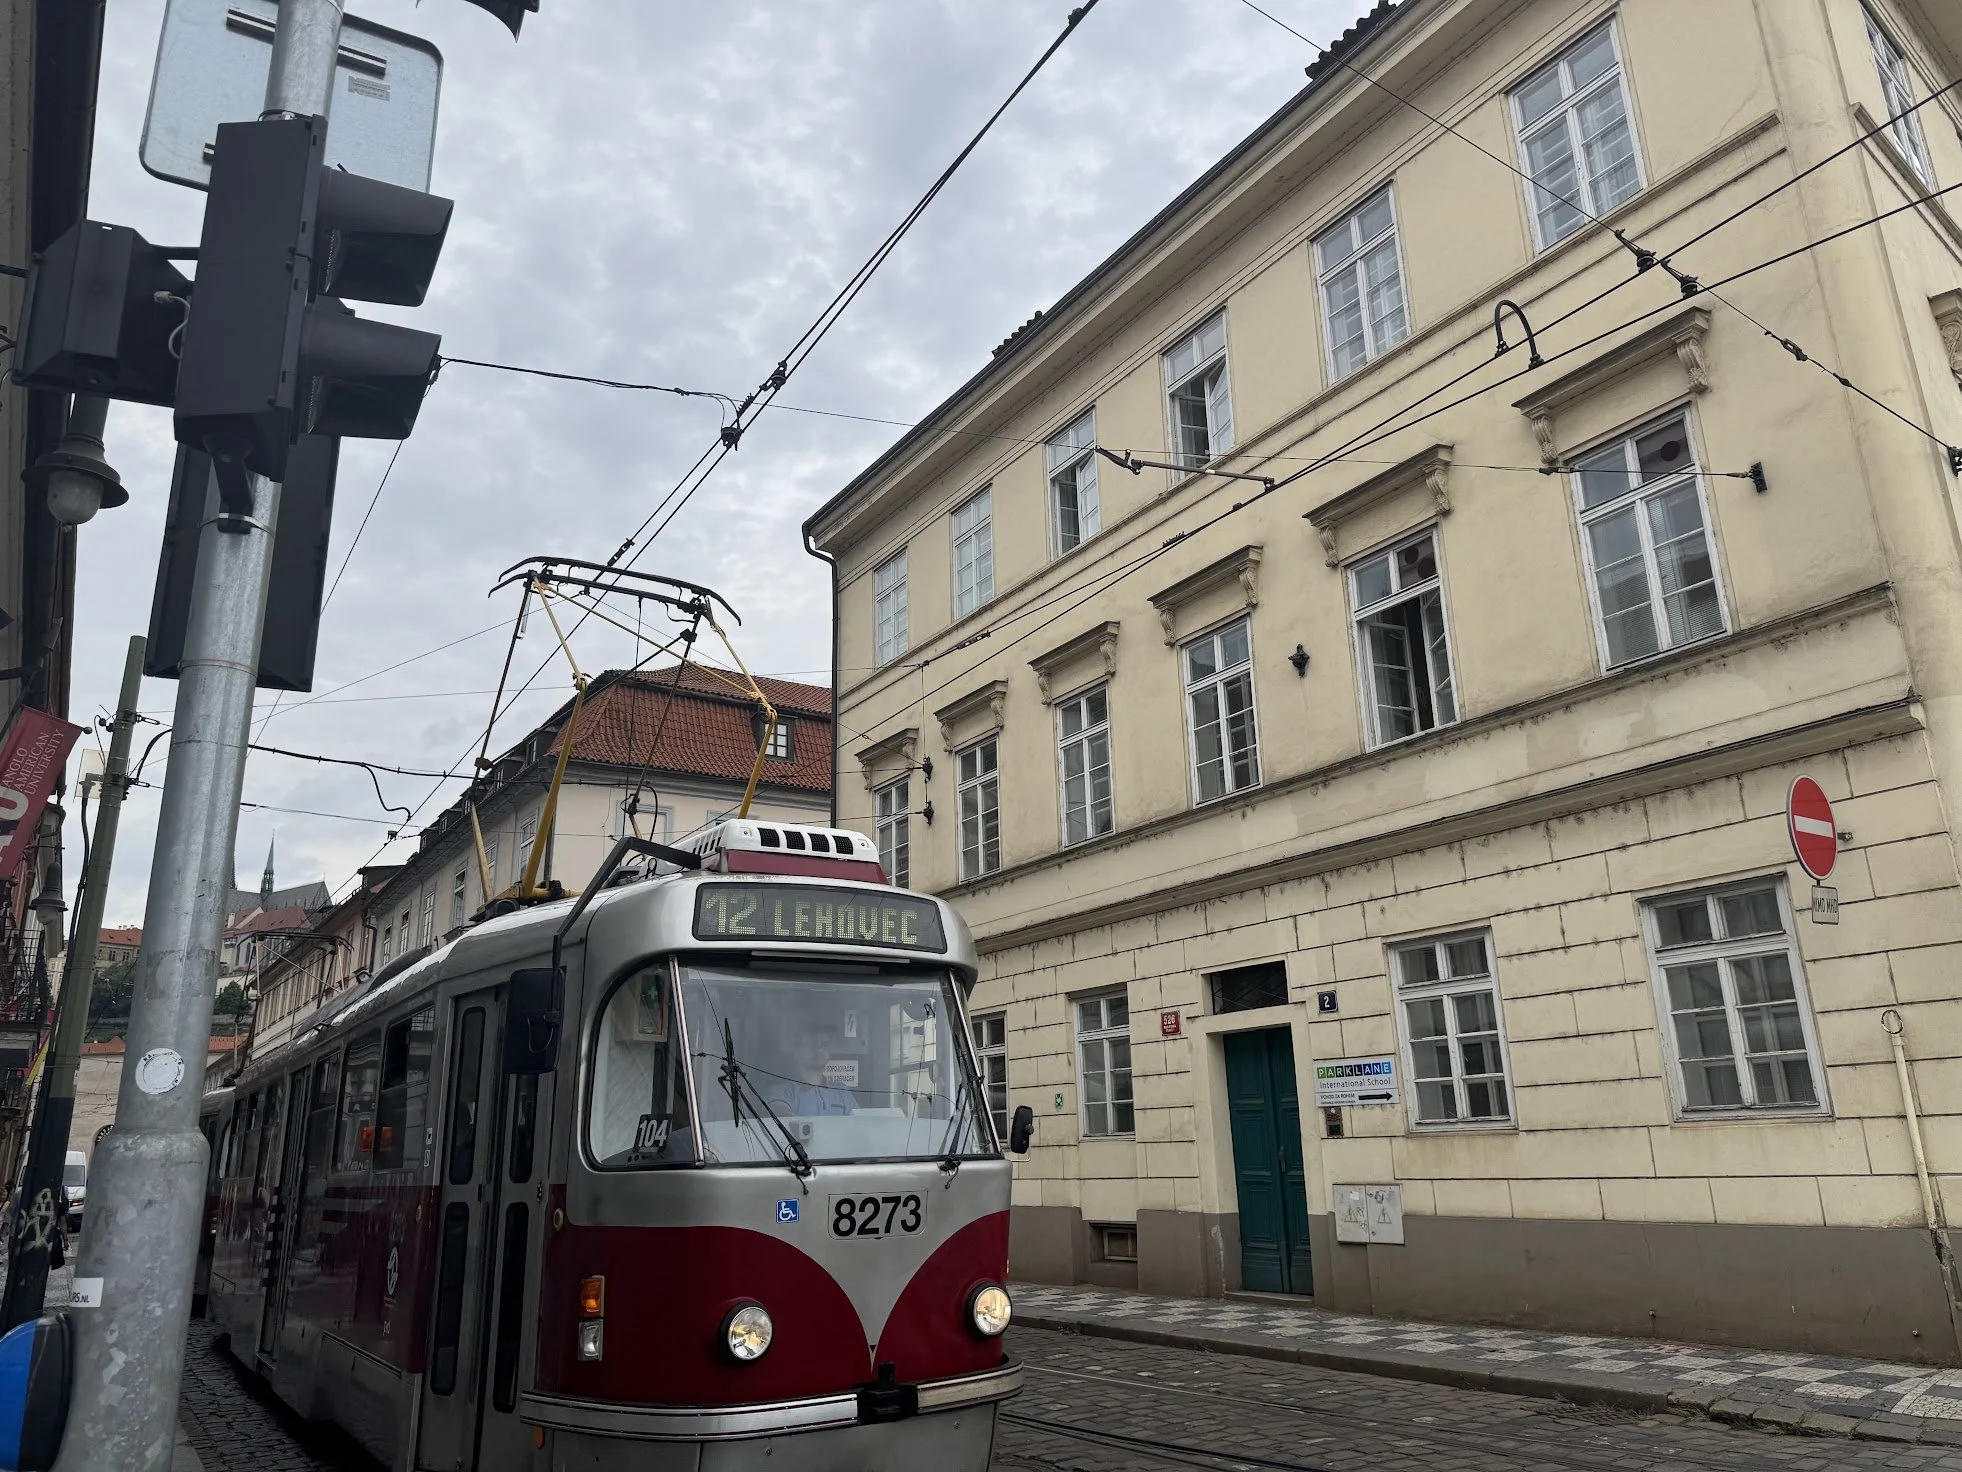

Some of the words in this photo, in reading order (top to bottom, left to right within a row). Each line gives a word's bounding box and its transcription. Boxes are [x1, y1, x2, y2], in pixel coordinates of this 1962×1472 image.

[2, 747, 28, 788] ANGLO
[14, 732, 50, 793] AMERICAN
[24, 729, 65, 795] UNIVERSITY
[706, 892, 757, 935] 12
[774, 899, 917, 944] LEHOVEC
[1324, 996, 1330, 1008] 2
[1164, 1014, 1176, 1025] 526
[1318, 1062, 1390, 1078] PARKLANE
[1320, 1079, 1366, 1089] International
[1368, 1077, 1391, 1086] School
[638, 1120, 669, 1147] 104
[832, 1194, 922, 1237] 8273
